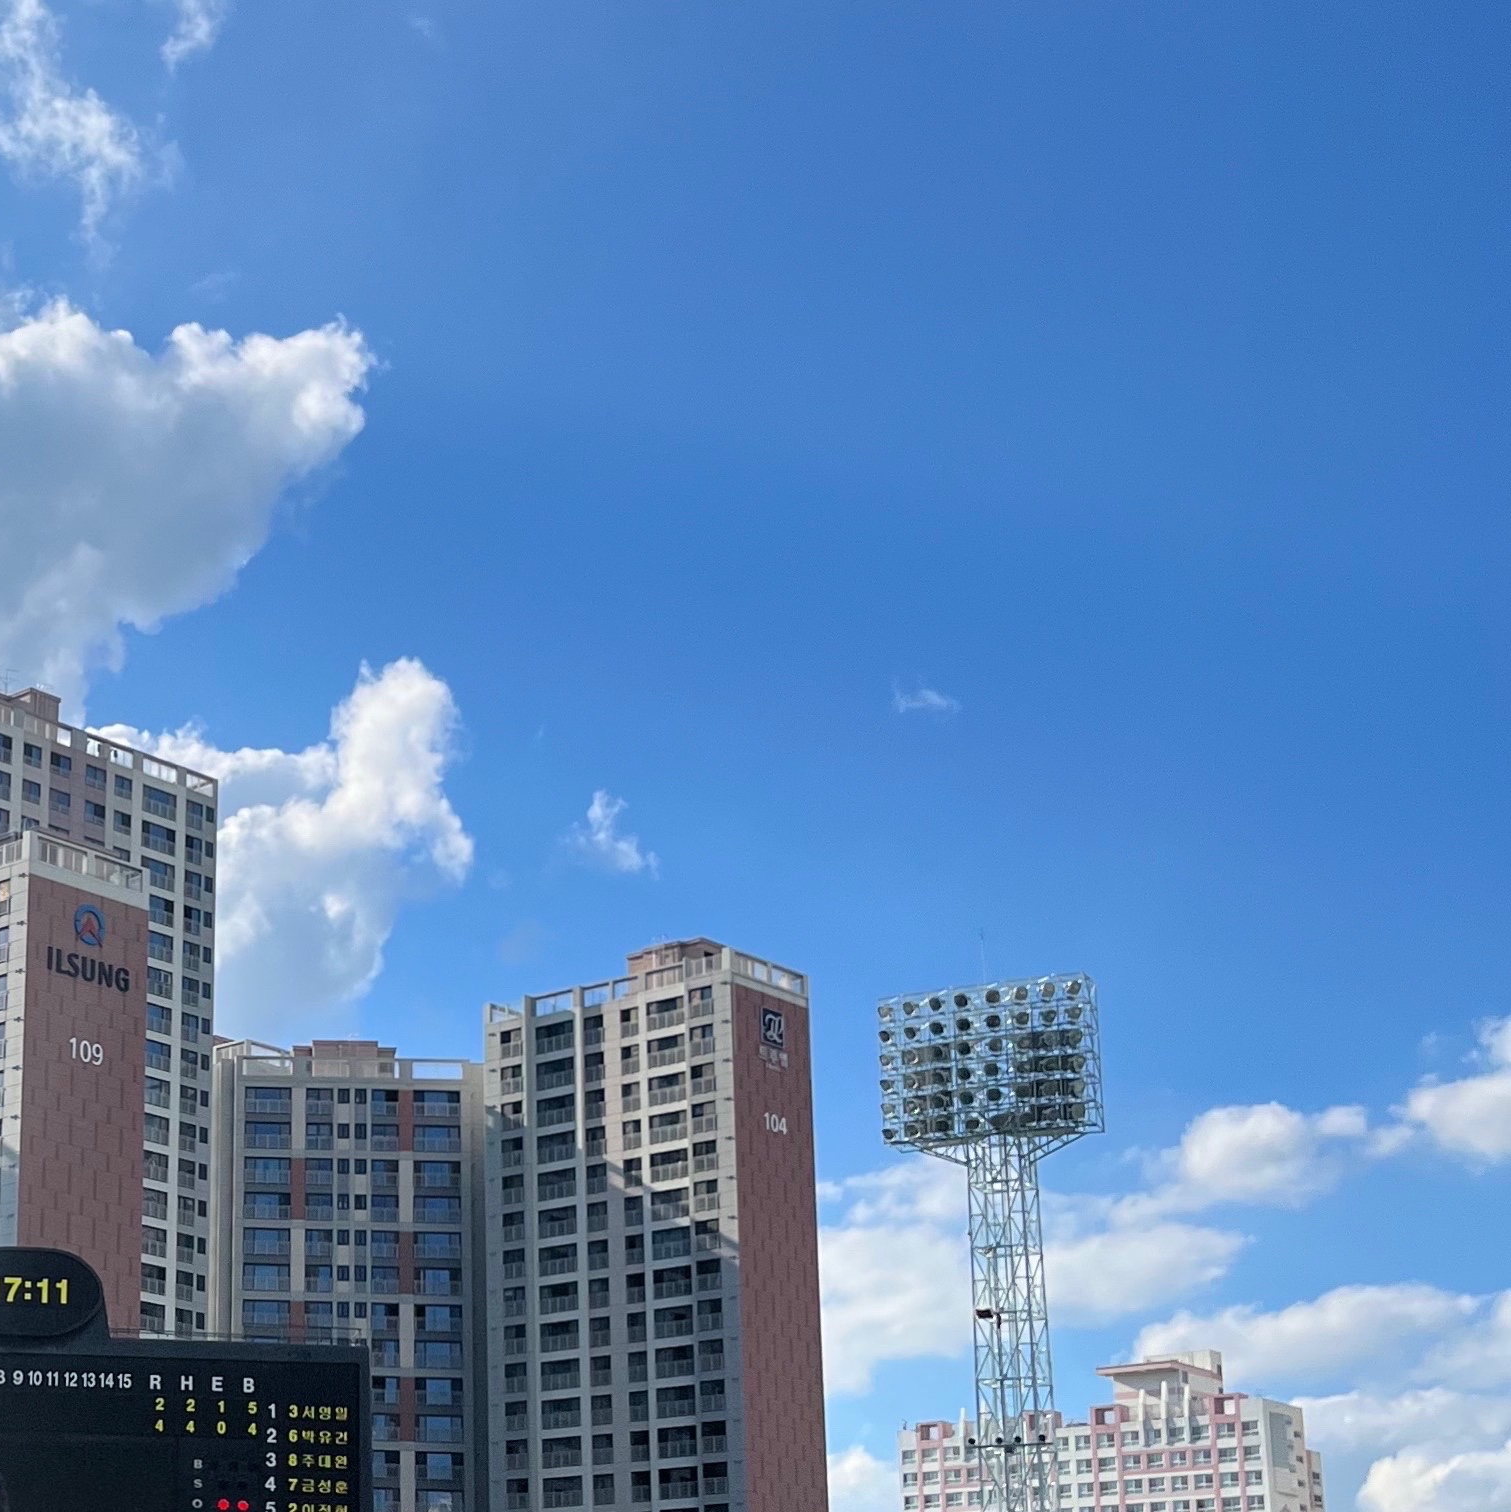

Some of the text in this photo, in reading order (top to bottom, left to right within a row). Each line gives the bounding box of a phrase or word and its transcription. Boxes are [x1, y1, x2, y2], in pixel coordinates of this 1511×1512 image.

[46, 945, 130, 992] ILSUNG
[69, 1037, 104, 1066] 109
[764, 1112, 787, 1135] 104
[13, 1370, 23, 1385] 9
[28, 1371, 42, 1385] 10
[47, 1371, 58, 1386] 11
[64, 1372, 77, 1386] 12
[82, 1373, 95, 1387] 13
[99, 1373, 114, 1388] 14
[118, 1374, 131, 1388] 15
[150, 1375, 161, 1389] R
[181, 1376, 193, 1390] H
[212, 1377, 223, 1391] E
[244, 1378, 254, 1393] B
[156, 1398, 164, 1410] 2
[187, 1399, 195, 1411] 2
[218, 1401, 224, 1412] 1
[248, 1402, 257, 1414] 5
[268, 1404, 275, 1418] 1
[155, 1420, 163, 1431] 4
[186, 1421, 194, 1432] 4
[217, 1421, 226, 1434] 0
[248, 1423, 256, 1435] 4
[267, 1428, 276, 1443] 2
[266, 1453, 276, 1467] 3
[265, 1477, 276, 1491] 4
